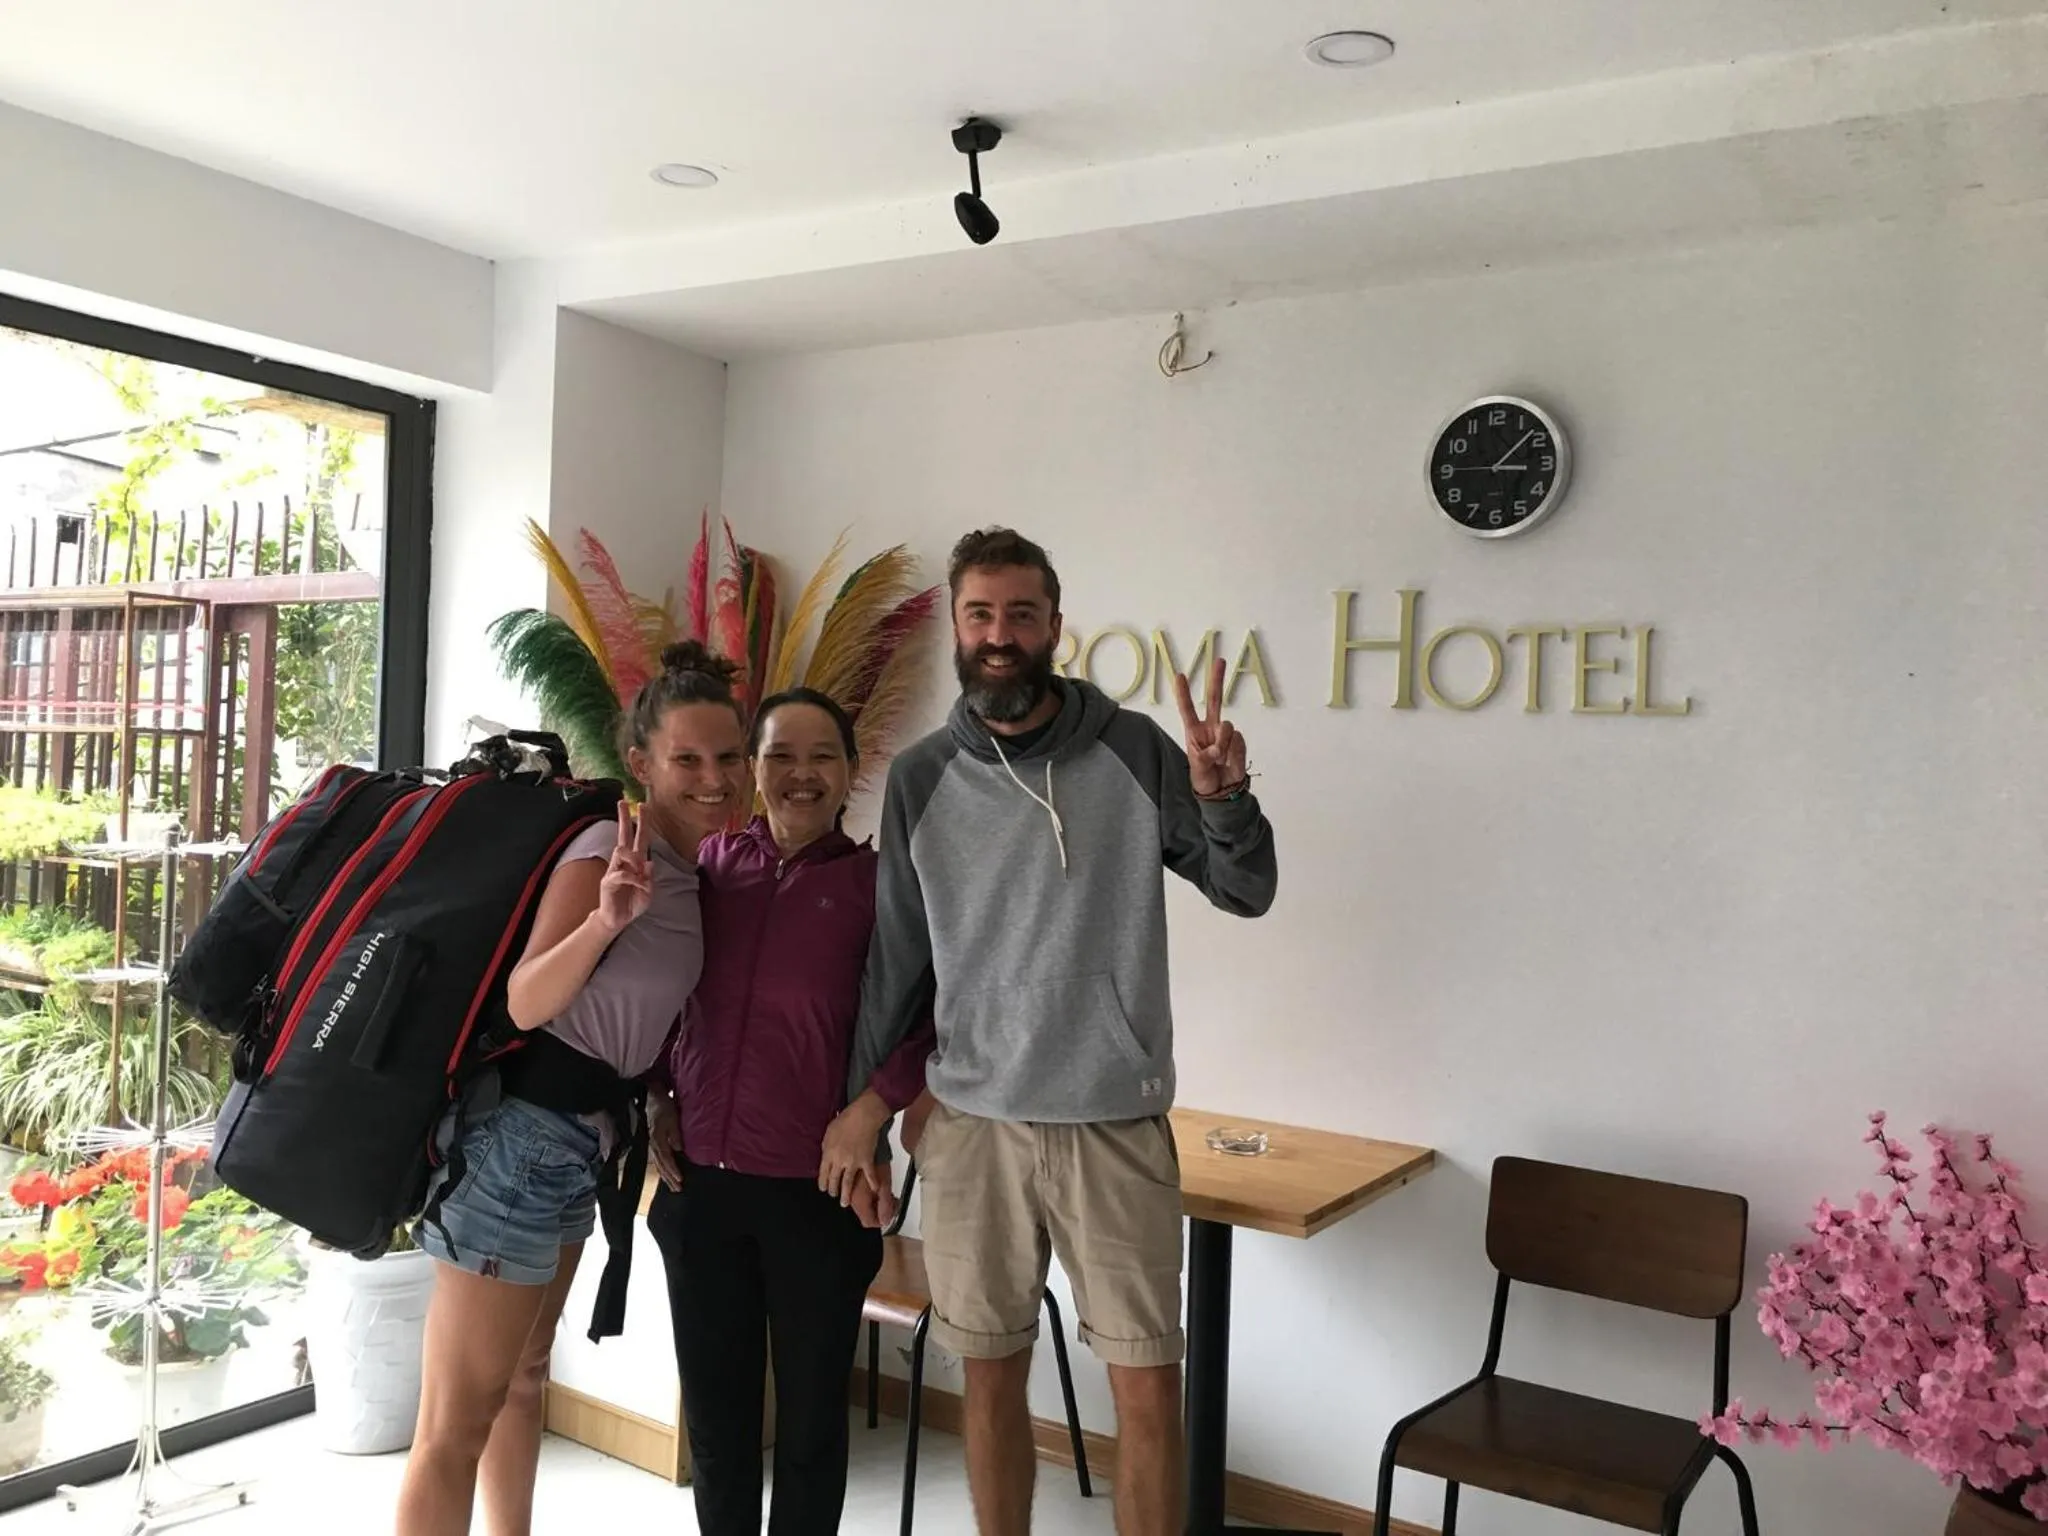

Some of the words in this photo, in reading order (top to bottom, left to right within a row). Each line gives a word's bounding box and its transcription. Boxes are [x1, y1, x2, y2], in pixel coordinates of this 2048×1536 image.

[1488, 410, 1507, 426] 12
[1519, 414, 1524, 430] 1
[1467, 419, 1478, 435] 11
[1450, 438, 1468, 454] 10
[1532, 432, 1546, 447] 2
[1540, 455, 1554, 471] 3
[1440, 464, 1454, 479] 9
[1448, 488, 1461, 503] 8
[1530, 481, 1545, 497] 4
[1466, 503, 1480, 519] 7
[1514, 500, 1527, 516] 5
[1488, 509, 1502, 525] 6
[1329, 587, 1692, 716] HOTEL
[352, 932, 385, 980] HIGH
[312, 981, 357, 1049] SIERRA
